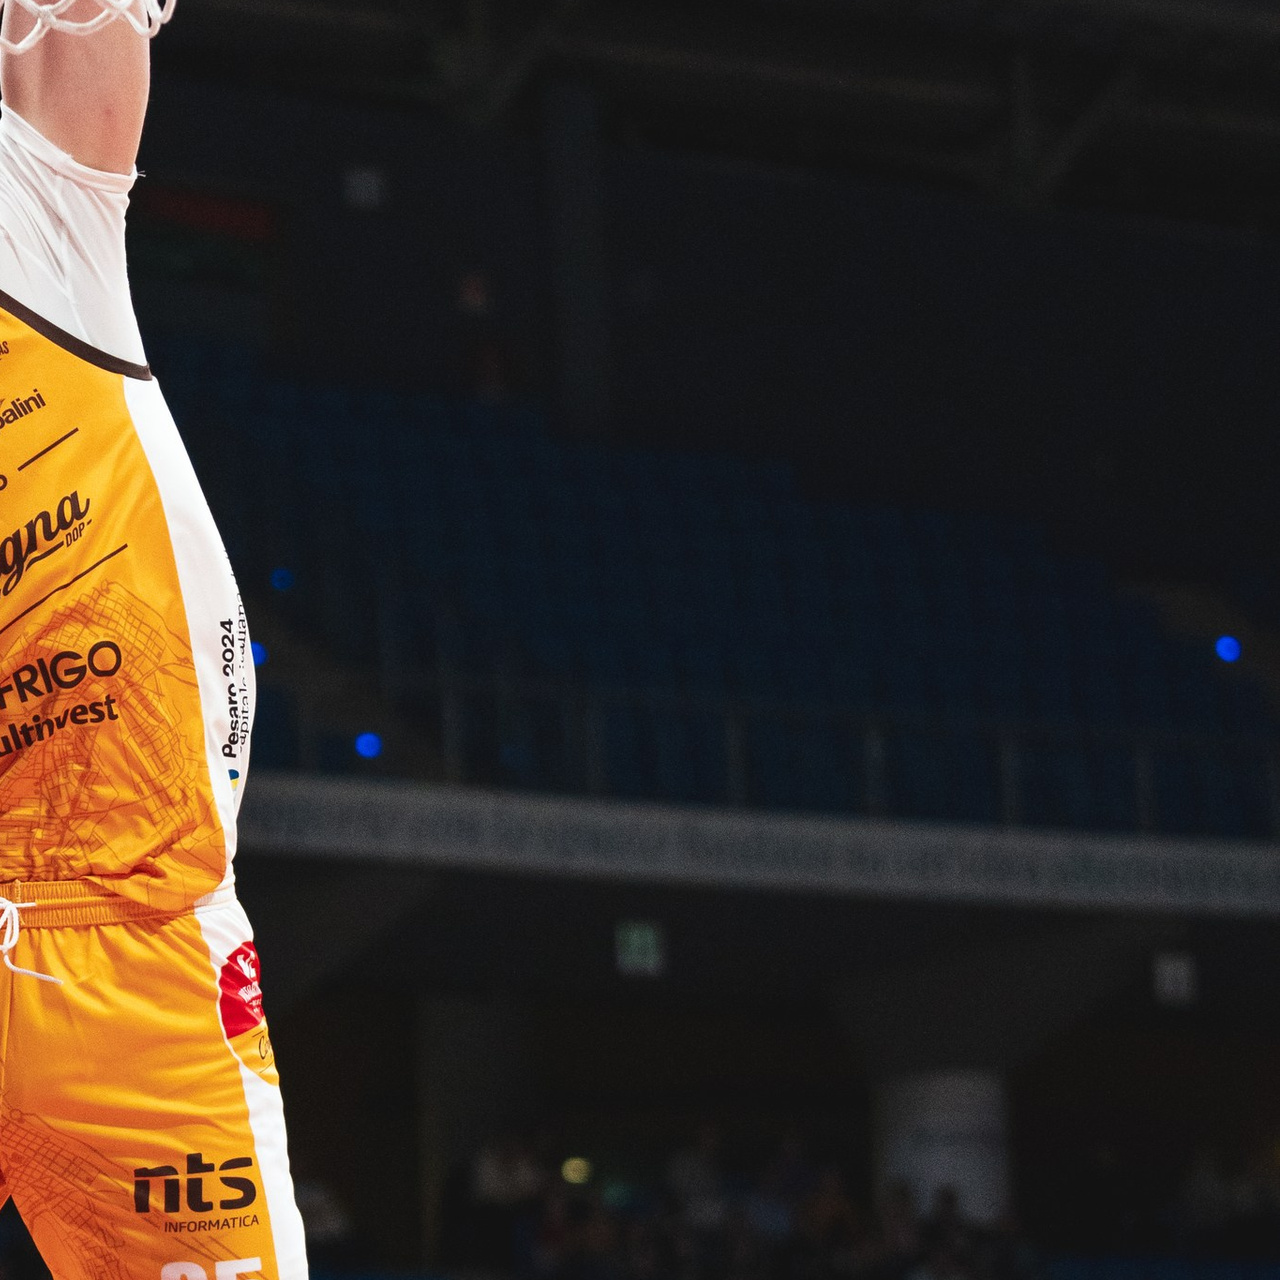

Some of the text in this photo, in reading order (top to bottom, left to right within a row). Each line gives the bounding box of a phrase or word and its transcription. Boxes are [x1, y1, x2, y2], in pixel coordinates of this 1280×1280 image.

[65, 521, 86, 548] DOP
[220, 618, 239, 759] Pesaro 2024
[134, 1152, 257, 1213] nts
[163, 1214, 260, 1233] INFORMATICA
